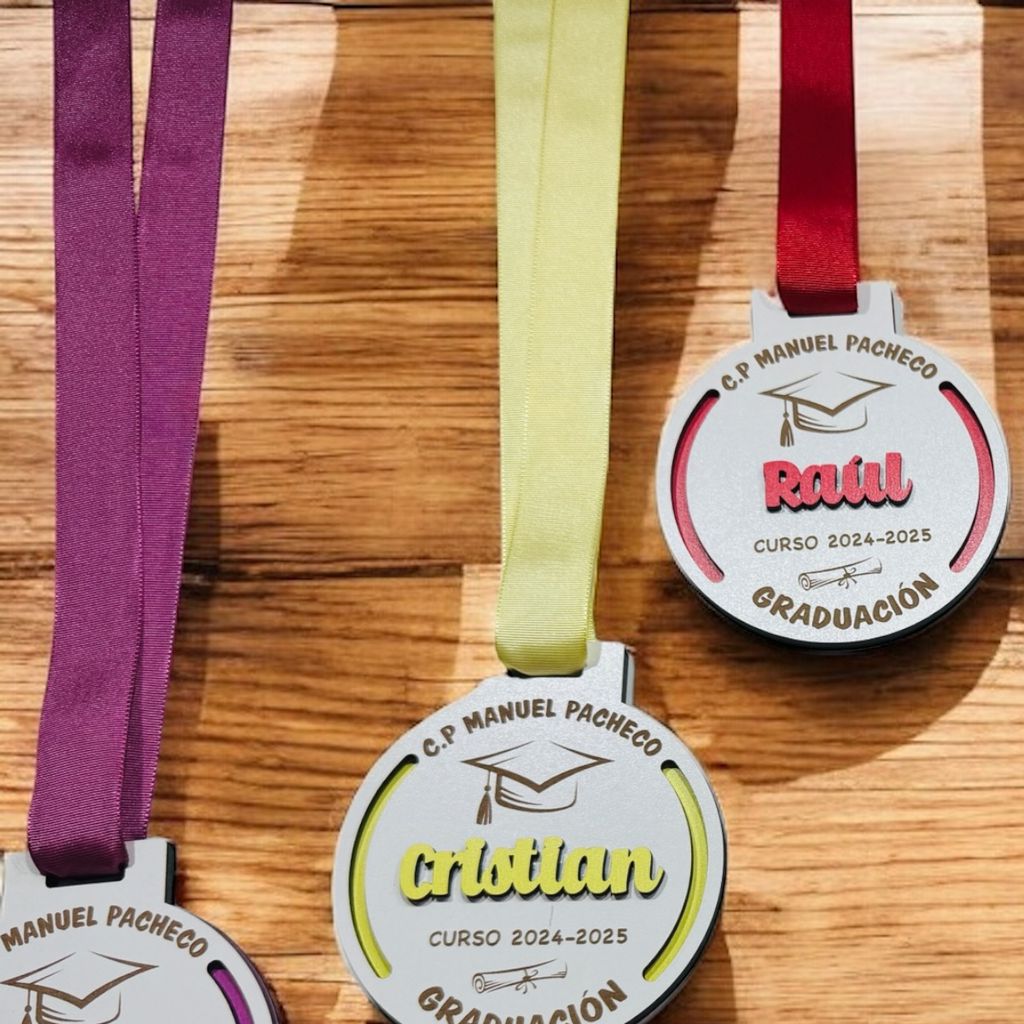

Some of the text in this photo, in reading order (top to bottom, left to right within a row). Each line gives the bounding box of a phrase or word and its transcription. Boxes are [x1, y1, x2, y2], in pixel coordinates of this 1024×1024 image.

[721, 333, 938, 391] C.P MANUEL PACHECO
[762, 452, 913, 513] Raúl
[753, 528, 932, 553] CURSO 2024-2025
[752, 571, 940, 631] GRADUACIÓN
[422, 698, 663, 758] C.P MANUEL PACHECO
[399, 835, 666, 905] Cristian
[0, 904, 209, 959] MANUEL PACHECO
[428, 927, 629, 947] CURSO 2024-2025
